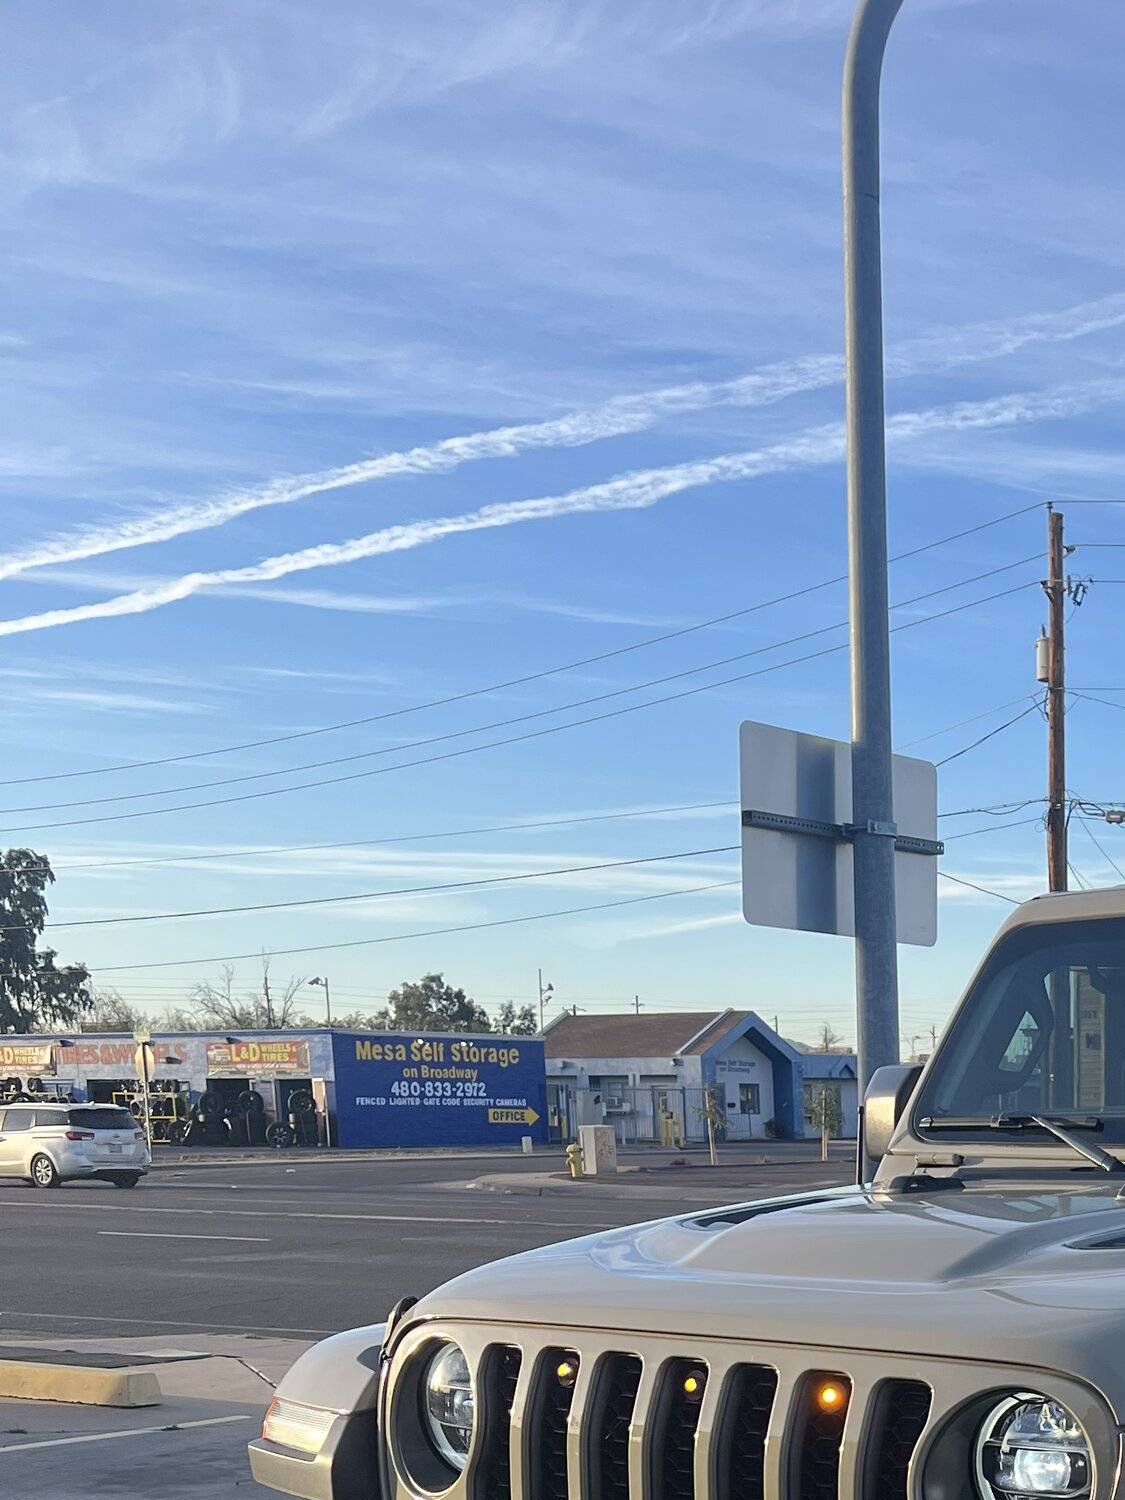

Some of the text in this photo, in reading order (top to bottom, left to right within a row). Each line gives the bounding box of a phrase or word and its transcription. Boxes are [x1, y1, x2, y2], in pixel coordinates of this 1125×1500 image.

[262, 1053, 289, 1063] TIRES
[355, 1040, 520, 1068] Mesa Self Storage
[403, 1065, 478, 1081] on Broadway
[391, 1081, 486, 1097] 480-833-2972
[355, 1097, 527, 1107] FENCED LIGHTED GATE CODE SECURITY CAMERAS
[492, 1110, 526, 1121] OFFICE
